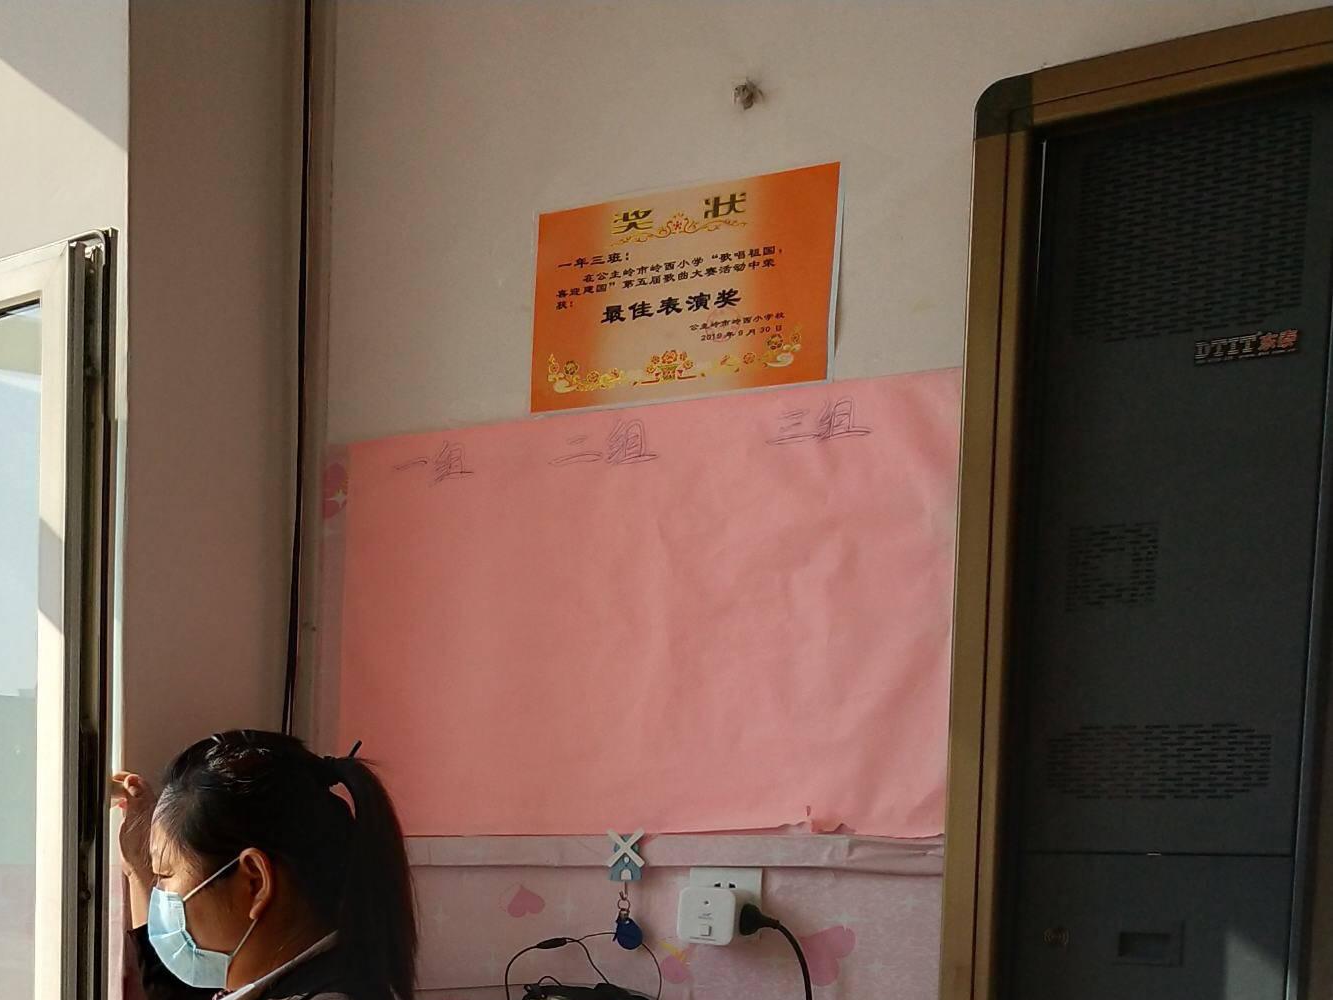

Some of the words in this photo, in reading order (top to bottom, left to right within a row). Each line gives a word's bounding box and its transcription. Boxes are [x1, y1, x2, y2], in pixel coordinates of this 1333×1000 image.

[600, 288, 742, 324] 最佳表演奖
[547, 419, 659, 466] 二组
[764, 396, 872, 446] 三组
